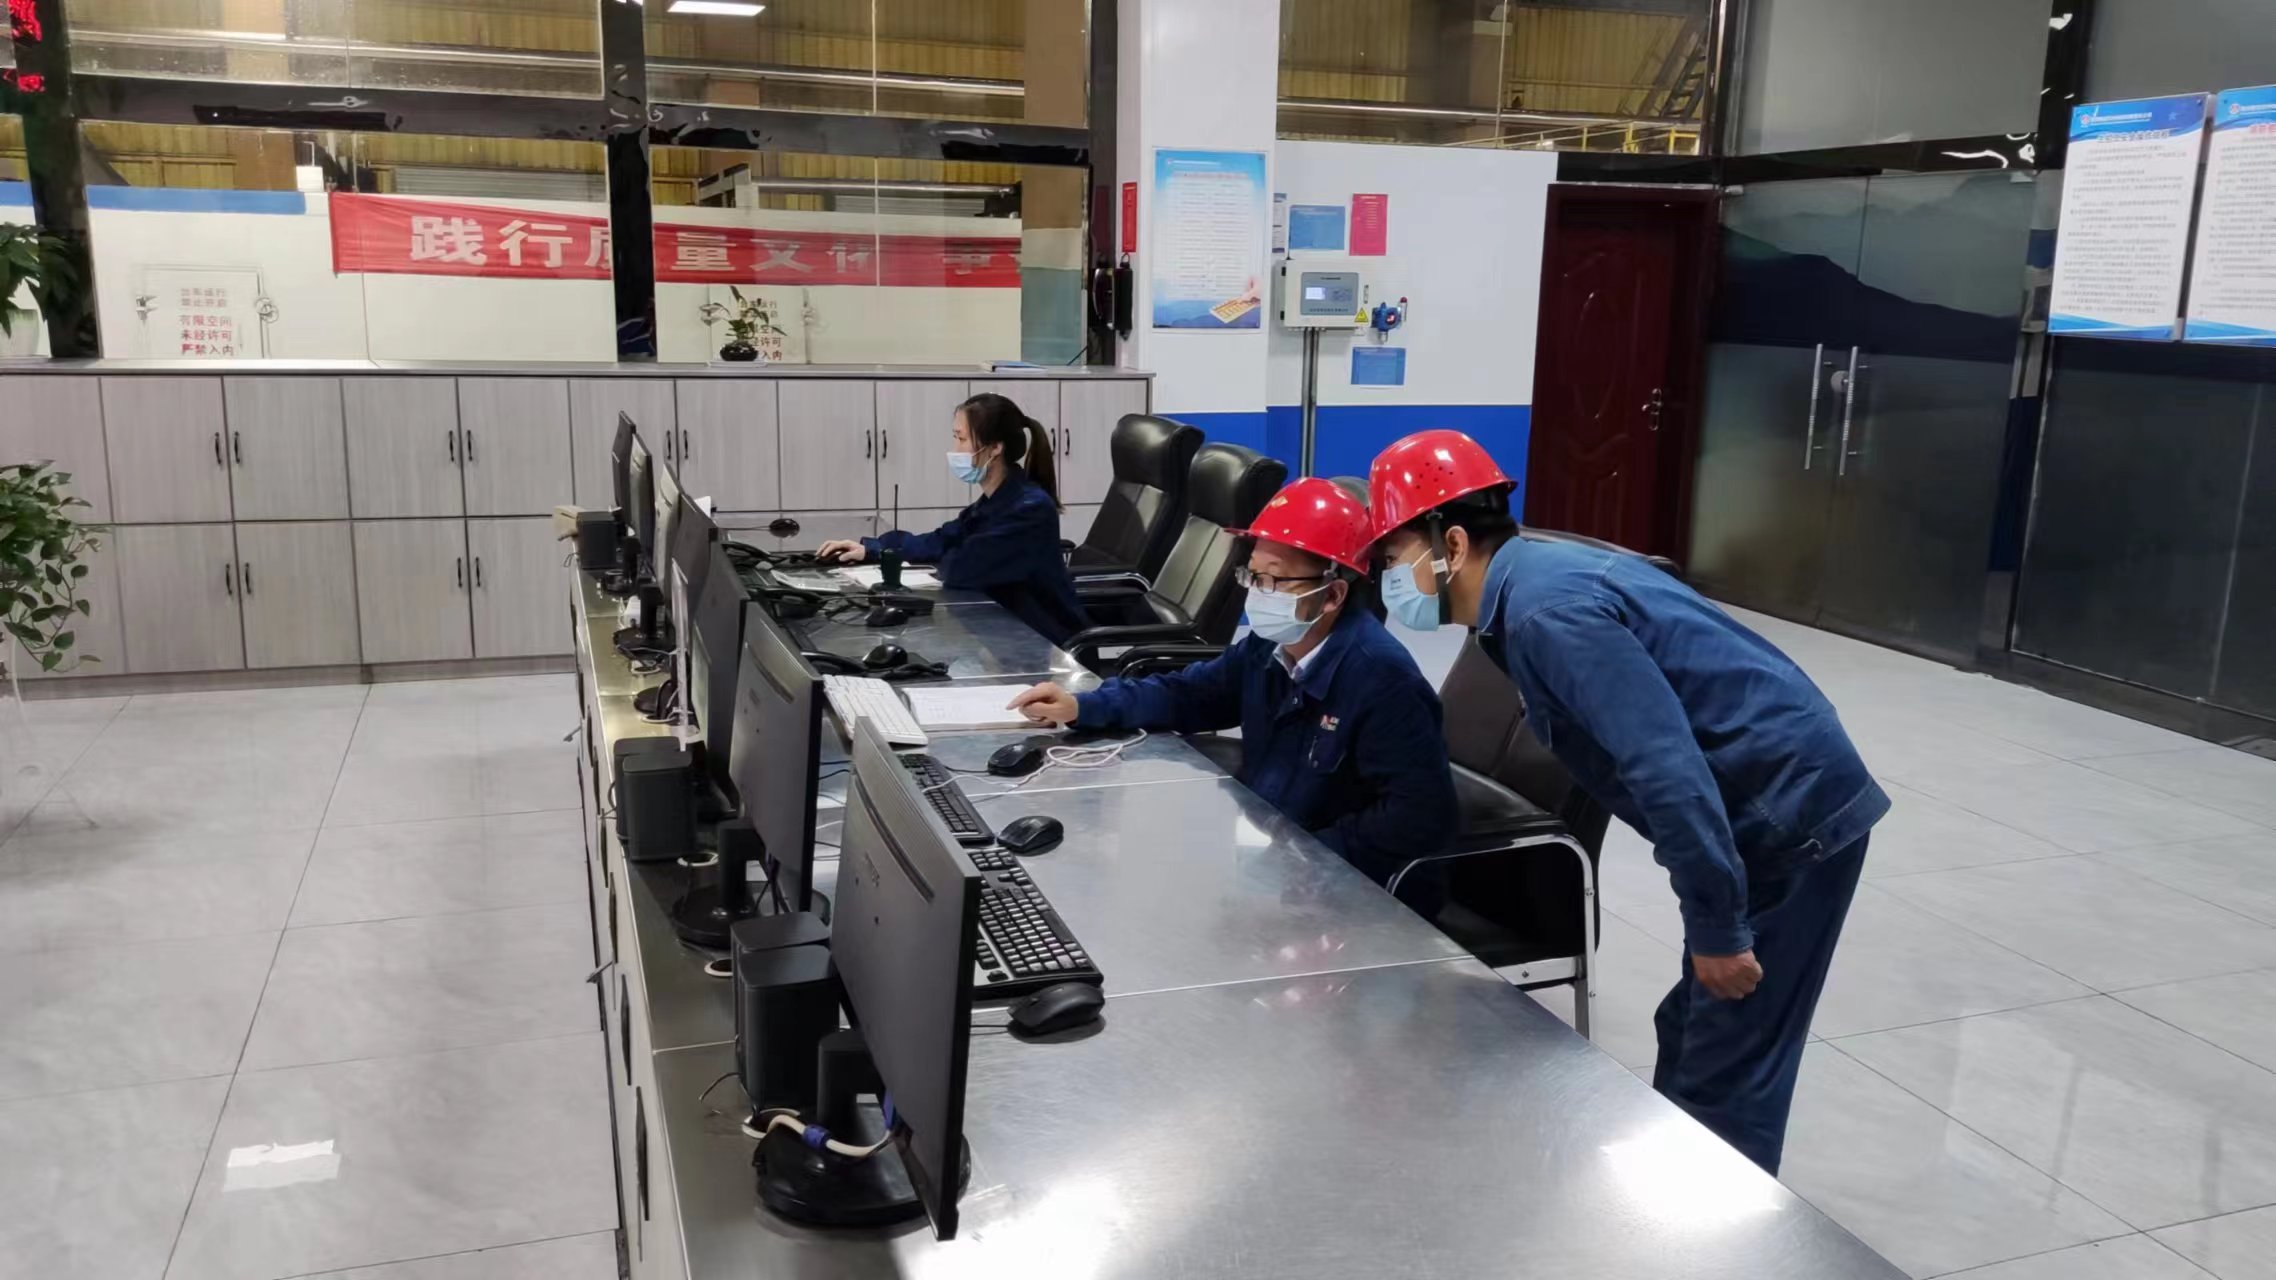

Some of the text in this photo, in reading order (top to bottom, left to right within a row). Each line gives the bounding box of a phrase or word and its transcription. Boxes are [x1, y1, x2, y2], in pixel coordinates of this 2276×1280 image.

[179, 315, 232, 326] 有限空间
[181, 329, 232, 341] 未经许可
[181, 343, 234, 355] 严禁入内
